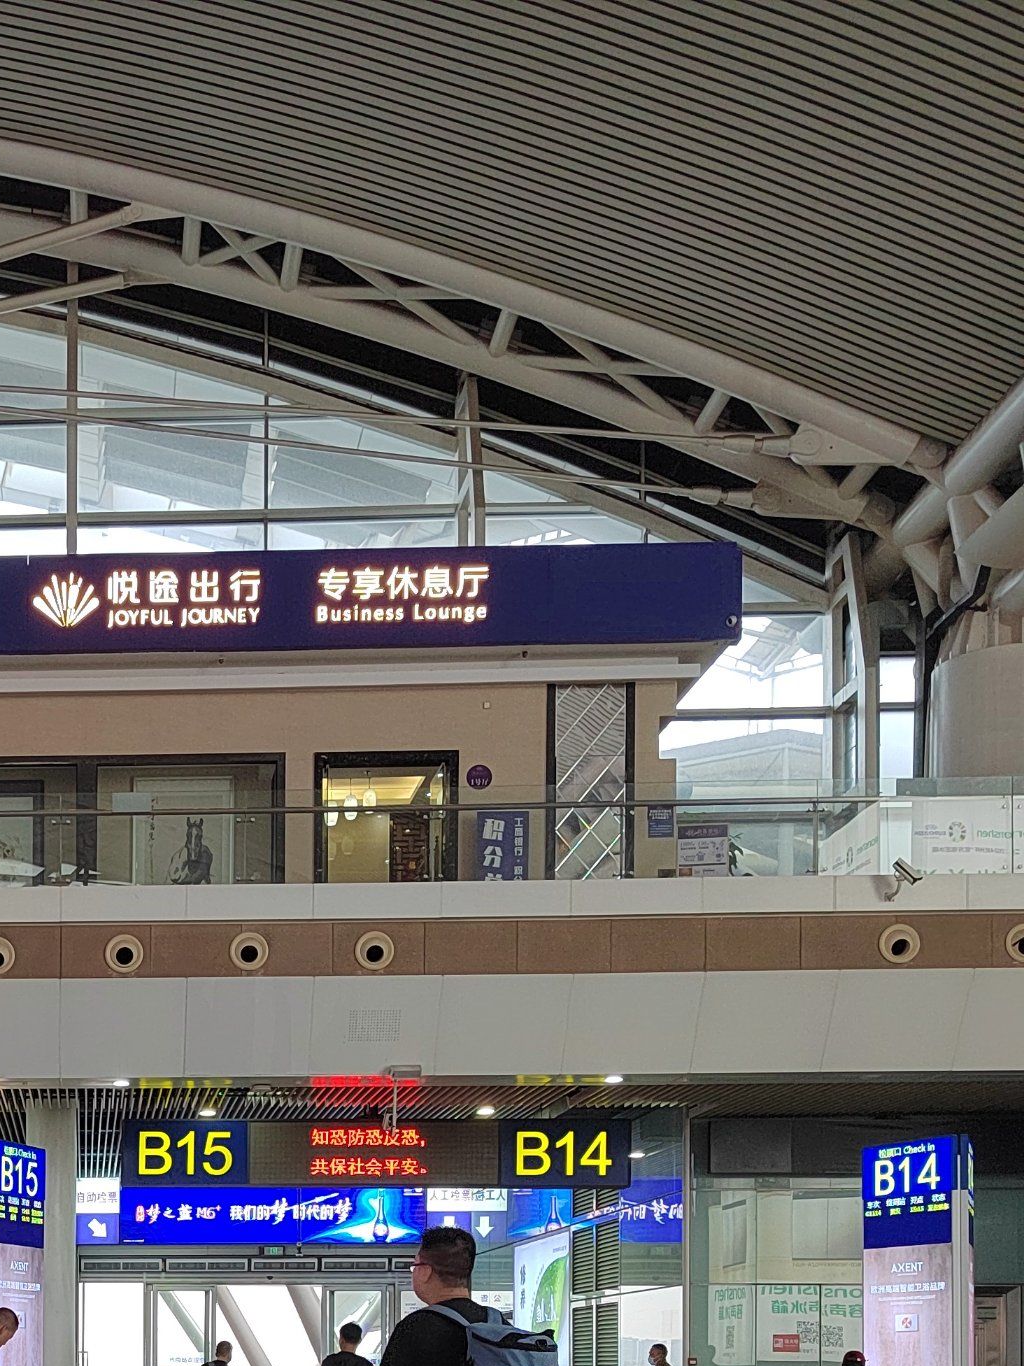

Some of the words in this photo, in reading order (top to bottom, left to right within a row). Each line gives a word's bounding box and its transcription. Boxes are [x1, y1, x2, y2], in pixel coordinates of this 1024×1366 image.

[107, 569, 261, 604] 悦途出行
[317, 565, 490, 600] 专享休息厅
[107, 608, 174, 628] JOYFUL
[180, 607, 261, 627] JOURNEY
[316, 604, 404, 622] Business
[413, 603, 488, 623] Lounge
[138, 1130, 233, 1176] B15
[516, 1130, 613, 1176] B14
[903, 1143, 926, 1154] Check
[927, 1142, 935, 1152] in
[0, 1155, 39, 1197] B15
[874, 1152, 941, 1197] B14
[145, 1203, 192, 1224] 梦之蓝
[891, 1262, 923, 1273] AXENT
